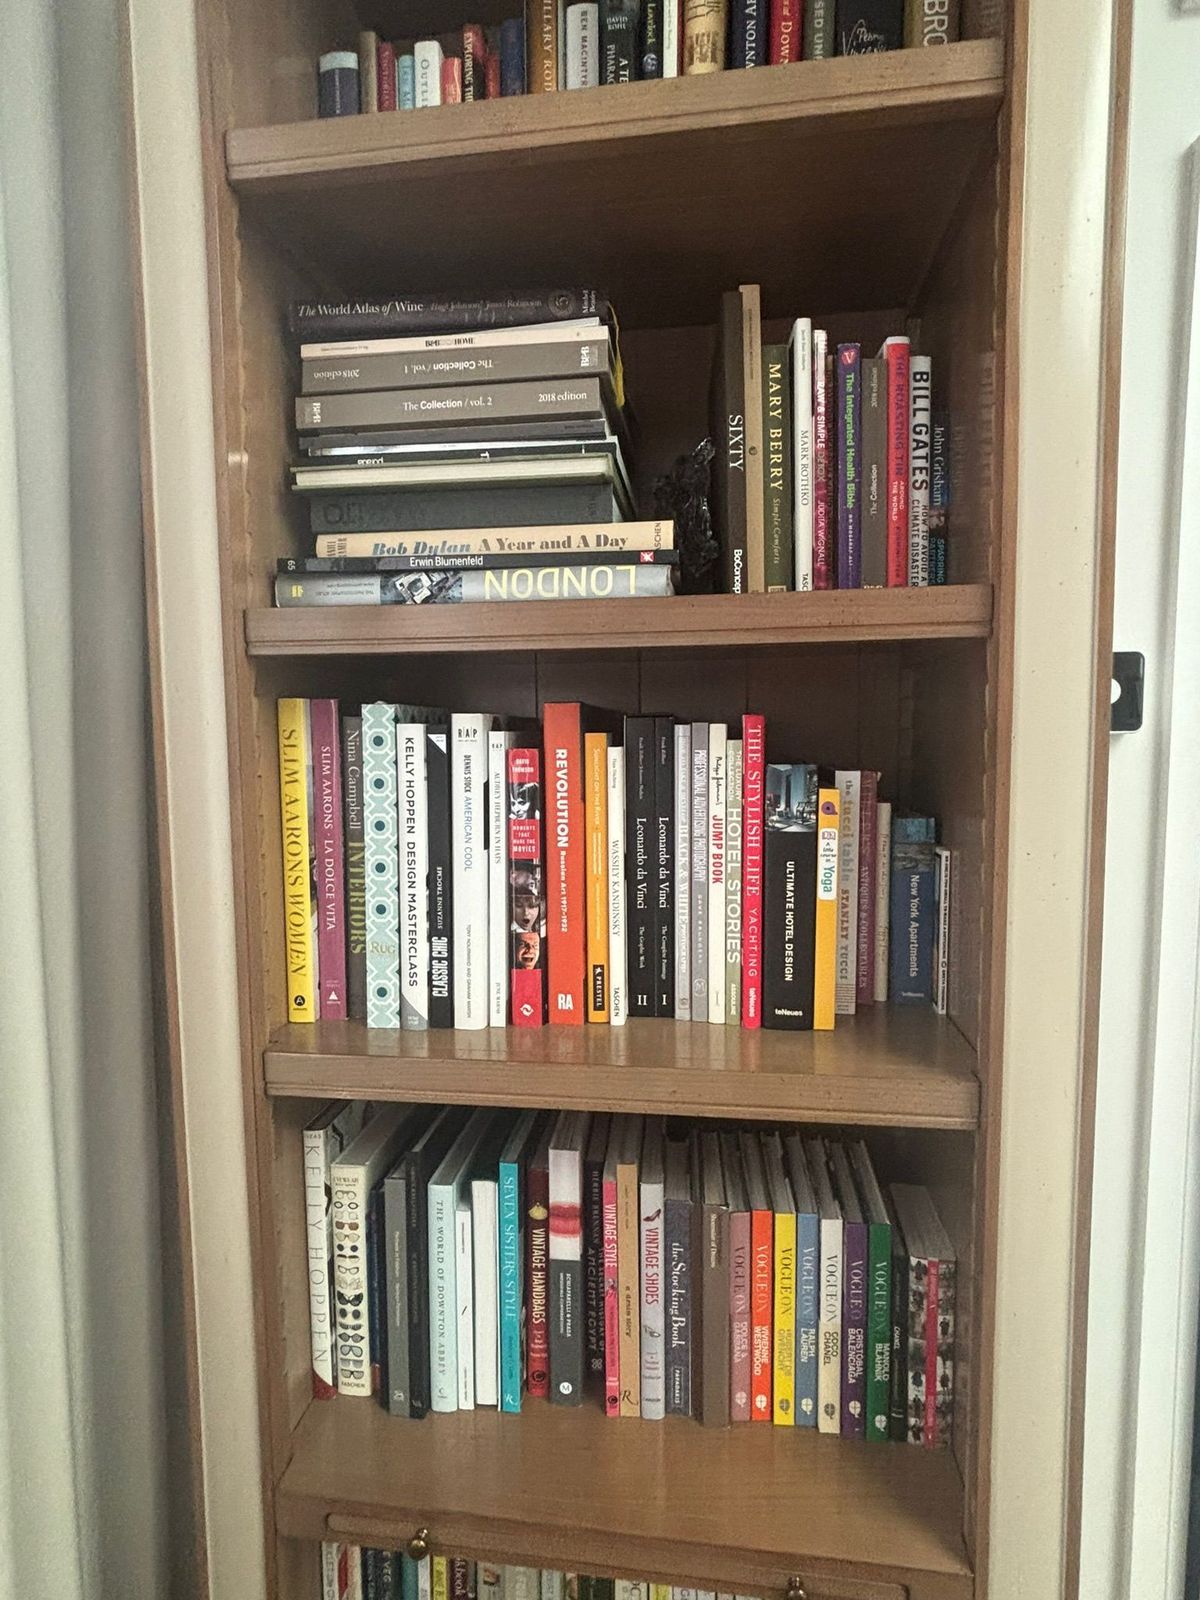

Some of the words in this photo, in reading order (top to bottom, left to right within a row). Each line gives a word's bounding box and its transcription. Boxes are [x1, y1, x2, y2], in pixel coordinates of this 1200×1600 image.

[580, 10, 588, 31] BEN
[463, 32, 474, 84] EXPLORING
[580, 36, 588, 86] MACINTYR
[619, 58, 629, 67] A
[421, 59, 430, 107] OUTLI
[317, 303, 350, 316] World
[352, 302, 380, 314] Atlas
[381, 301, 394, 315] of
[395, 301, 424, 312] Wine
[313, 370, 342, 380] edition
[342, 368, 360, 378] 2018
[433, 360, 476, 372] Collection
[476, 359, 494, 369] The
[845, 372, 855, 393] The
[402, 401, 419, 411] The
[419, 398, 463, 409] Collection
[470, 397, 486, 407] vol.
[486, 397, 493, 406] 2
[538, 392, 557, 403] 2018
[556, 390, 588, 401] edition
[767, 363, 782, 419] MARY
[816, 381, 826, 403] RAW
[912, 371, 929, 417] BILL
[817, 415, 826, 449] SIMPLE
[844, 394, 856, 446] Integrated
[895, 383, 905, 450] ROASTING
[728, 414, 744, 471] SIXTY
[800, 430, 809, 461] MARK
[911, 422, 929, 491] GATES
[932, 424, 944, 454] John
[768, 428, 783, 491] BERRY
[846, 447, 856, 480] Health
[800, 462, 810, 506] ROTHKO
[846, 482, 856, 509] Bible
[932, 456, 945, 506] Grisham
[910, 499, 920, 541] CLIMATE
[920, 504, 928, 523] HOW
[372, 542, 407, 556] Bob
[413, 540, 469, 556] Dylan
[477, 538, 490, 553] A
[490, 536, 535, 552] Year
[537, 535, 571, 550] and
[576, 535, 590, 549] A
[595, 533, 629, 550] Day
[920, 529, 928, 541] TO
[408, 556, 431, 569] Erwin
[431, 554, 482, 567] Blumenfeld
[910, 542, 920, 587] DISASTER
[920, 544, 928, 572] AVOID
[936, 538, 945, 583] SPARRING
[481, 565, 636, 600] LONDON
[280, 730, 300, 787] SLIM
[320, 748, 332, 779] SLIM
[347, 731, 360, 765] Nina
[404, 737, 415, 775] KELLY
[747, 725, 761, 764] THE
[322, 780, 333, 831] AARONS
[346, 768, 361, 831] Campbell
[463, 777, 473, 795] STOCK
[555, 748, 569, 846] REVOLUTION
[844, 780, 853, 796] the
[405, 779, 416, 833] HOPPEN
[464, 797, 473, 846] AMERICAN
[746, 771, 760, 850] STYLISH
[284, 795, 305, 888] AARONS
[324, 841, 334, 855] LA
[636, 818, 647, 866] Leonardo
[658, 817, 669, 865] Leonardo
[678, 824, 690, 866] BLACK
[711, 814, 723, 851] JUMP
[727, 807, 740, 876] HOTEL
[406, 841, 417, 888] DESIGN
[464, 847, 473, 873] COOL
[559, 850, 568, 880] Russian
[610, 839, 620, 877] WASSILY
[636, 868, 647, 880] da
[658, 867, 669, 880] da
[678, 868, 690, 876] &
[711, 853, 723, 885] BOOK
[746, 854, 760, 897] LIFE
[324, 860, 335, 900] DOLCE
[559, 881, 568, 894] Art
[636, 881, 647, 909] Vinci
[658, 881, 669, 908] Vinci
[785, 861, 795, 909] ULTIMATE
[820, 865, 835, 893] Yoga
[910, 875, 921, 896] New
[325, 904, 336, 932] VITA
[348, 842, 366, 956] INTERIORS
[611, 880, 621, 936] KANDINSKY
[678, 881, 690, 924] WHITE
[840, 888, 850, 942] STANLEY
[909, 897, 921, 919] York
[289, 894, 307, 978] WOMEN
[408, 892, 418, 986] MASTERCLASS
[727, 878, 741, 964] STORIES
[785, 911, 795, 941] HOTEL
[431, 935, 449, 956] CHIC
[748, 907, 759, 978] YACHTING
[784, 943, 794, 981] DESIGN
[907, 921, 920, 978] Apartments
[431, 959, 449, 996] CLASSIC
[306, 1145, 322, 1231] KELLY
[504, 1176, 516, 1219] SEVEN
[436, 1200, 445, 1222] THE
[604, 1203, 617, 1240] VINTAGE
[436, 1227, 445, 1263] WORLD
[502, 1224, 516, 1277] SISTERS
[532, 1228, 546, 1268] VINTAGE
[605, 1243, 617, 1268] STYLE
[645, 1228, 659, 1270] VINTAGE
[437, 1268, 445, 1280] OF
[733, 1245, 746, 1294] VOGUE
[755, 1244, 768, 1294] VOGUE
[780, 1247, 793, 1295] VOGUE
[802, 1247, 815, 1295] VOGUE
[826, 1254, 838, 1302] VOGUE
[850, 1260, 864, 1309] VOGUE
[874, 1262, 887, 1312] VOGUE
[310, 1247, 327, 1363] HOPPEN
[505, 1280, 517, 1321] STYLE
[532, 1270, 547, 1324] HANDBAGS
[645, 1272, 659, 1306] SHOES
[437, 1285, 446, 1339] DOWNTON
[438, 1342, 447, 1376] ABBEY
[753, 1325, 762, 1376] WESTWOOD
[761, 1325, 769, 1364] VIVIENNE
[800, 1327, 808, 1362] LAUREN
[823, 1331, 831, 1366] CHANEL
[830, 1331, 839, 1357] COCO
[848, 1327, 857, 1384] BALENCIAGA
[874, 1343, 882, 1382] BLAHNIK
[882, 1343, 890, 1382] MANOLO
